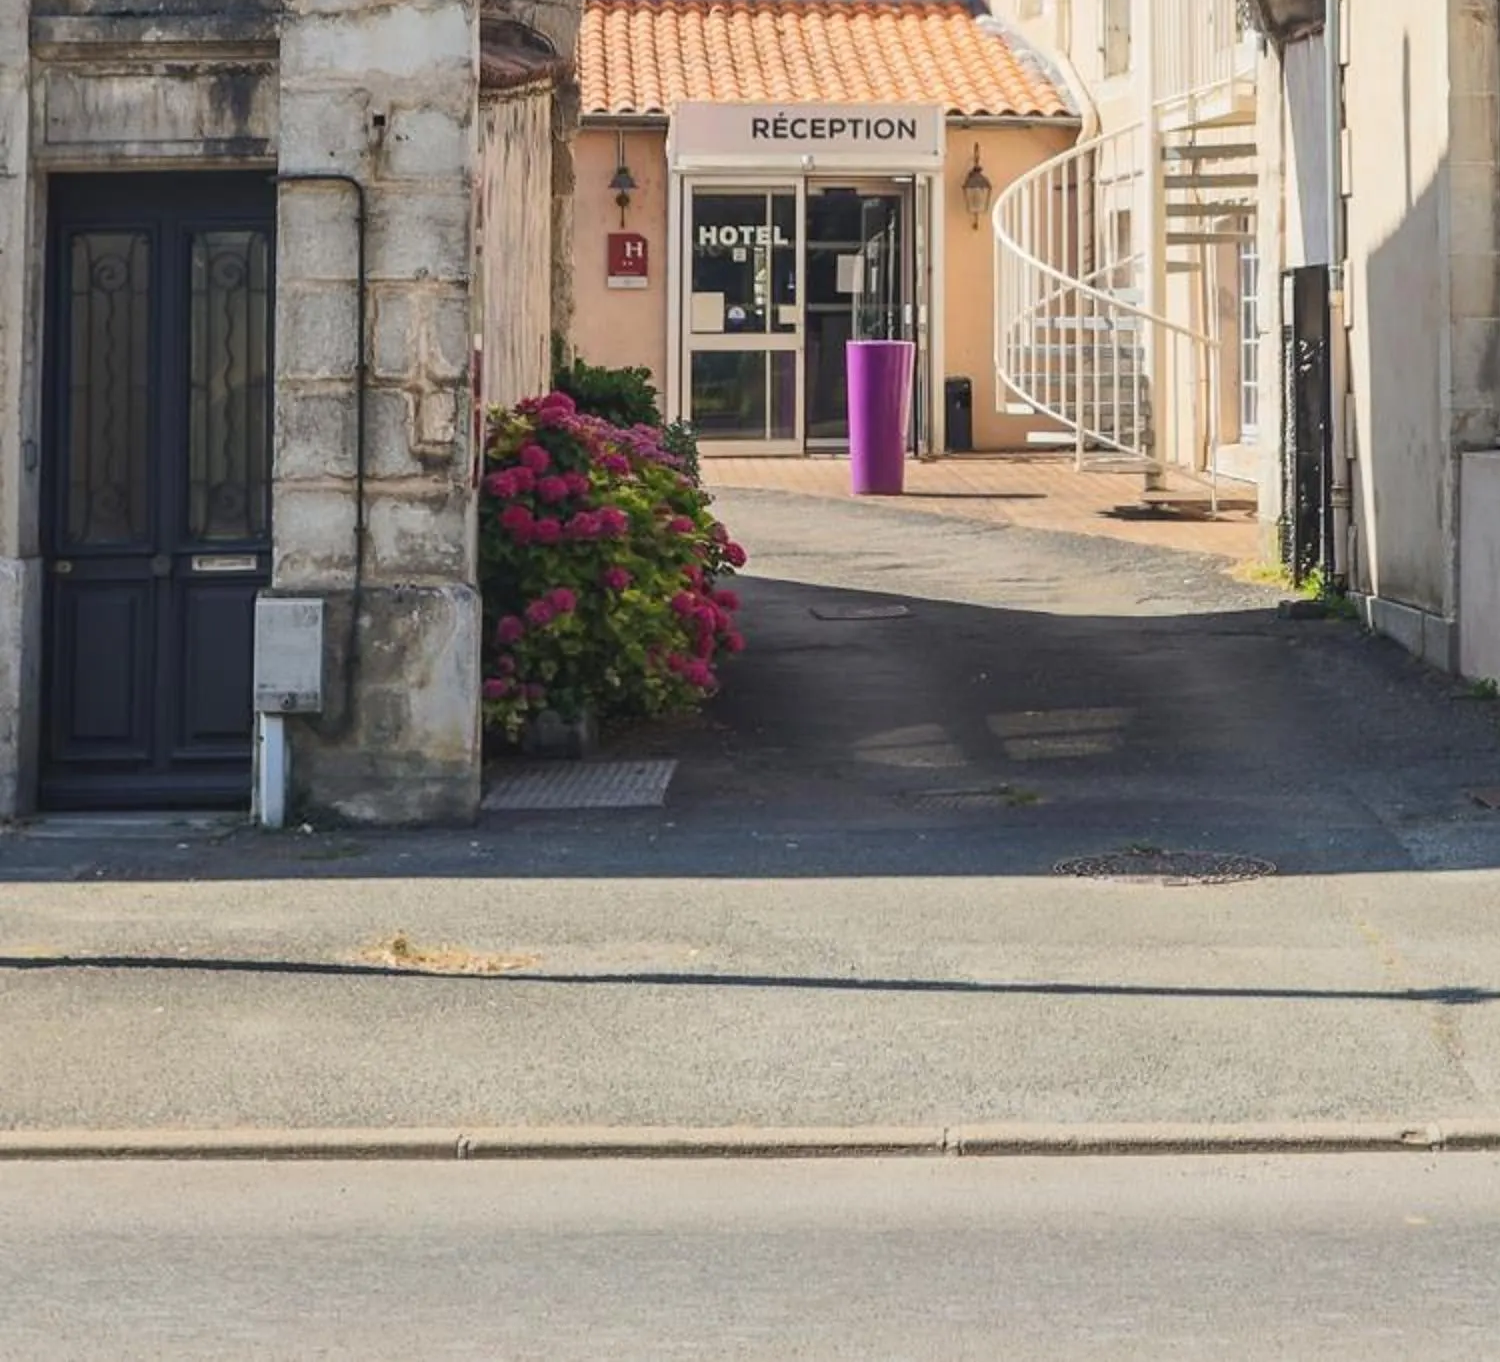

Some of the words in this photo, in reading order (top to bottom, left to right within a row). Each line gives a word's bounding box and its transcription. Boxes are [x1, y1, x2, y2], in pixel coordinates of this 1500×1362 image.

[752, 111, 917, 139] RÉCEPTION
[699, 225, 789, 245] HOTEL
[625, 241, 644, 258] H
